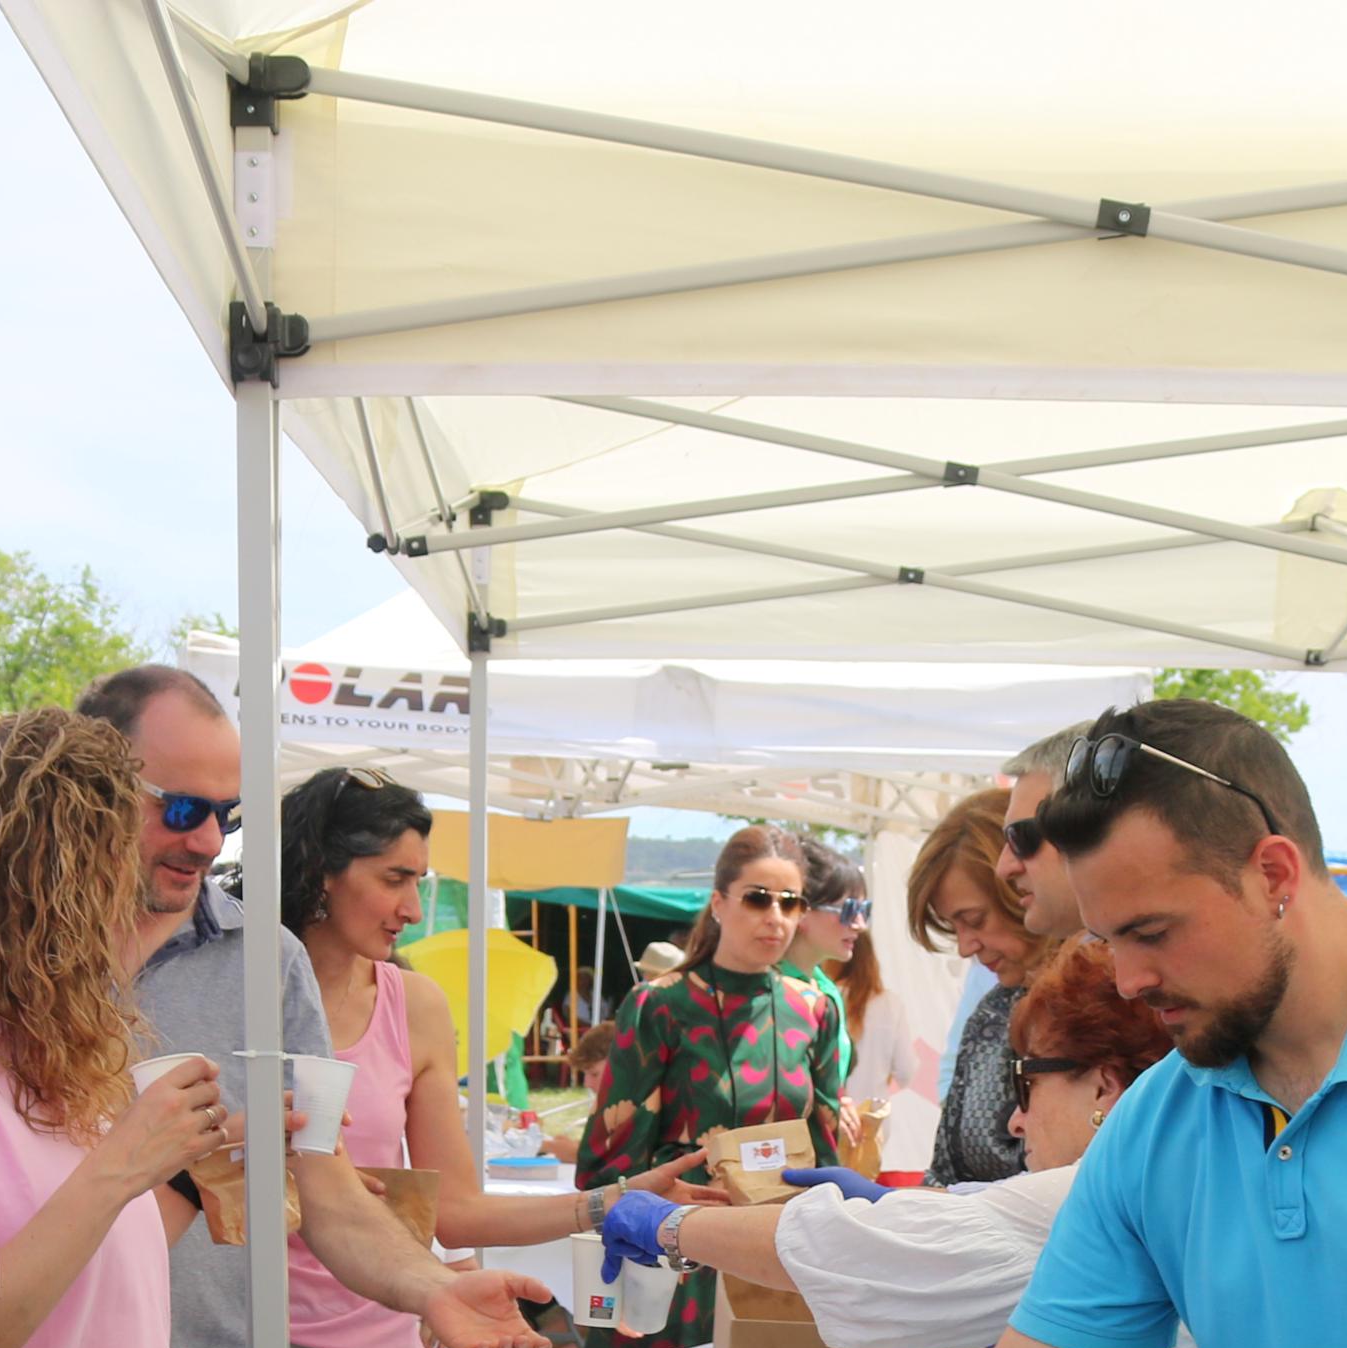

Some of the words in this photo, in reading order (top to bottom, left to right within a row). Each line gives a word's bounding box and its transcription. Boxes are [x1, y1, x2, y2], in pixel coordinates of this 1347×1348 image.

[233, 662, 470, 715] OLAR
[323, 715, 350, 727] TO
[355, 718, 410, 731] YOUR
